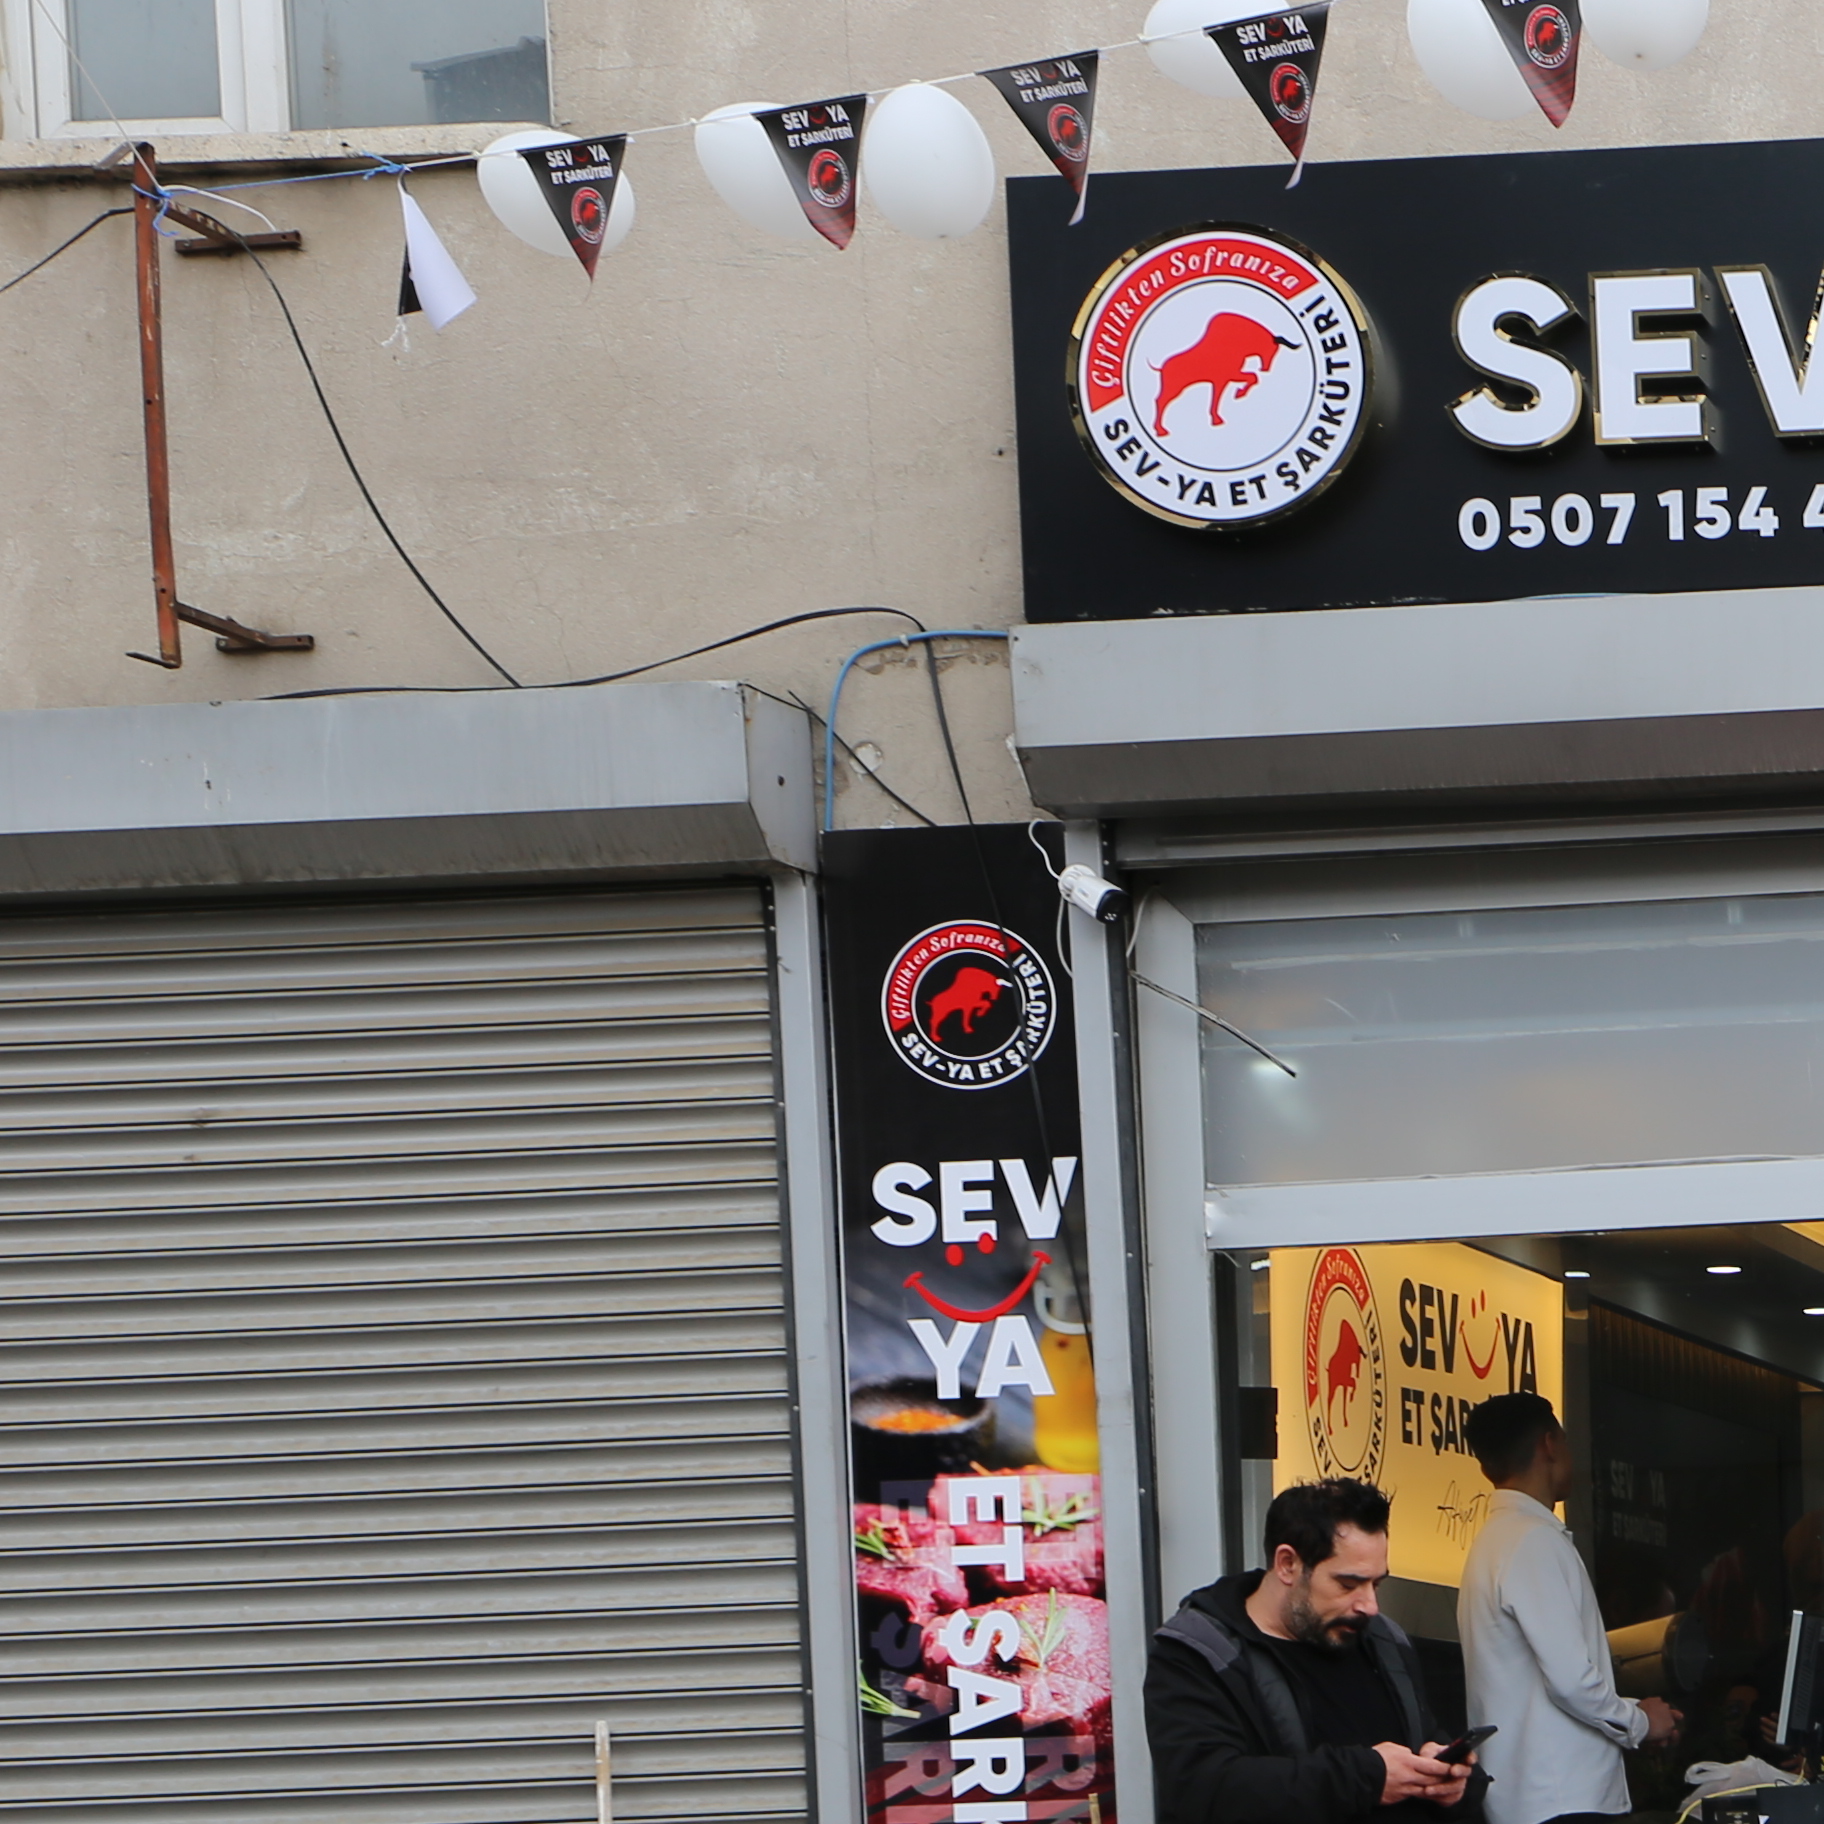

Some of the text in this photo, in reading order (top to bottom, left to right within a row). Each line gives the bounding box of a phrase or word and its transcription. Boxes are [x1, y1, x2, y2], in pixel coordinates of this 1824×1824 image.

[1236, 14, 1309, 46] SEV YA
[1010, 60, 1081, 87] SEV YA
[780, 103, 850, 131] SEV YA
[545, 144, 611, 168] SEV YA
[1091, 245, 1301, 389] Çiftlikten Sofranıza
[1229, 474, 1269, 507] ET
[1275, 293, 1351, 492] ŞARKÜTERİ
[1457, 493, 1637, 551] 0507
[1657, 487, 1778, 540] 154
[978, 1057, 1003, 1079] ET
[870, 1156, 1078, 1247] SEV
[907, 1315, 1056, 1399] YA
[1400, 1277, 1459, 1374] SEV
[1501, 1312, 1537, 1396] YA
[1401, 1386, 1425, 1447] ET
[948, 1476, 1025, 1582] ET
